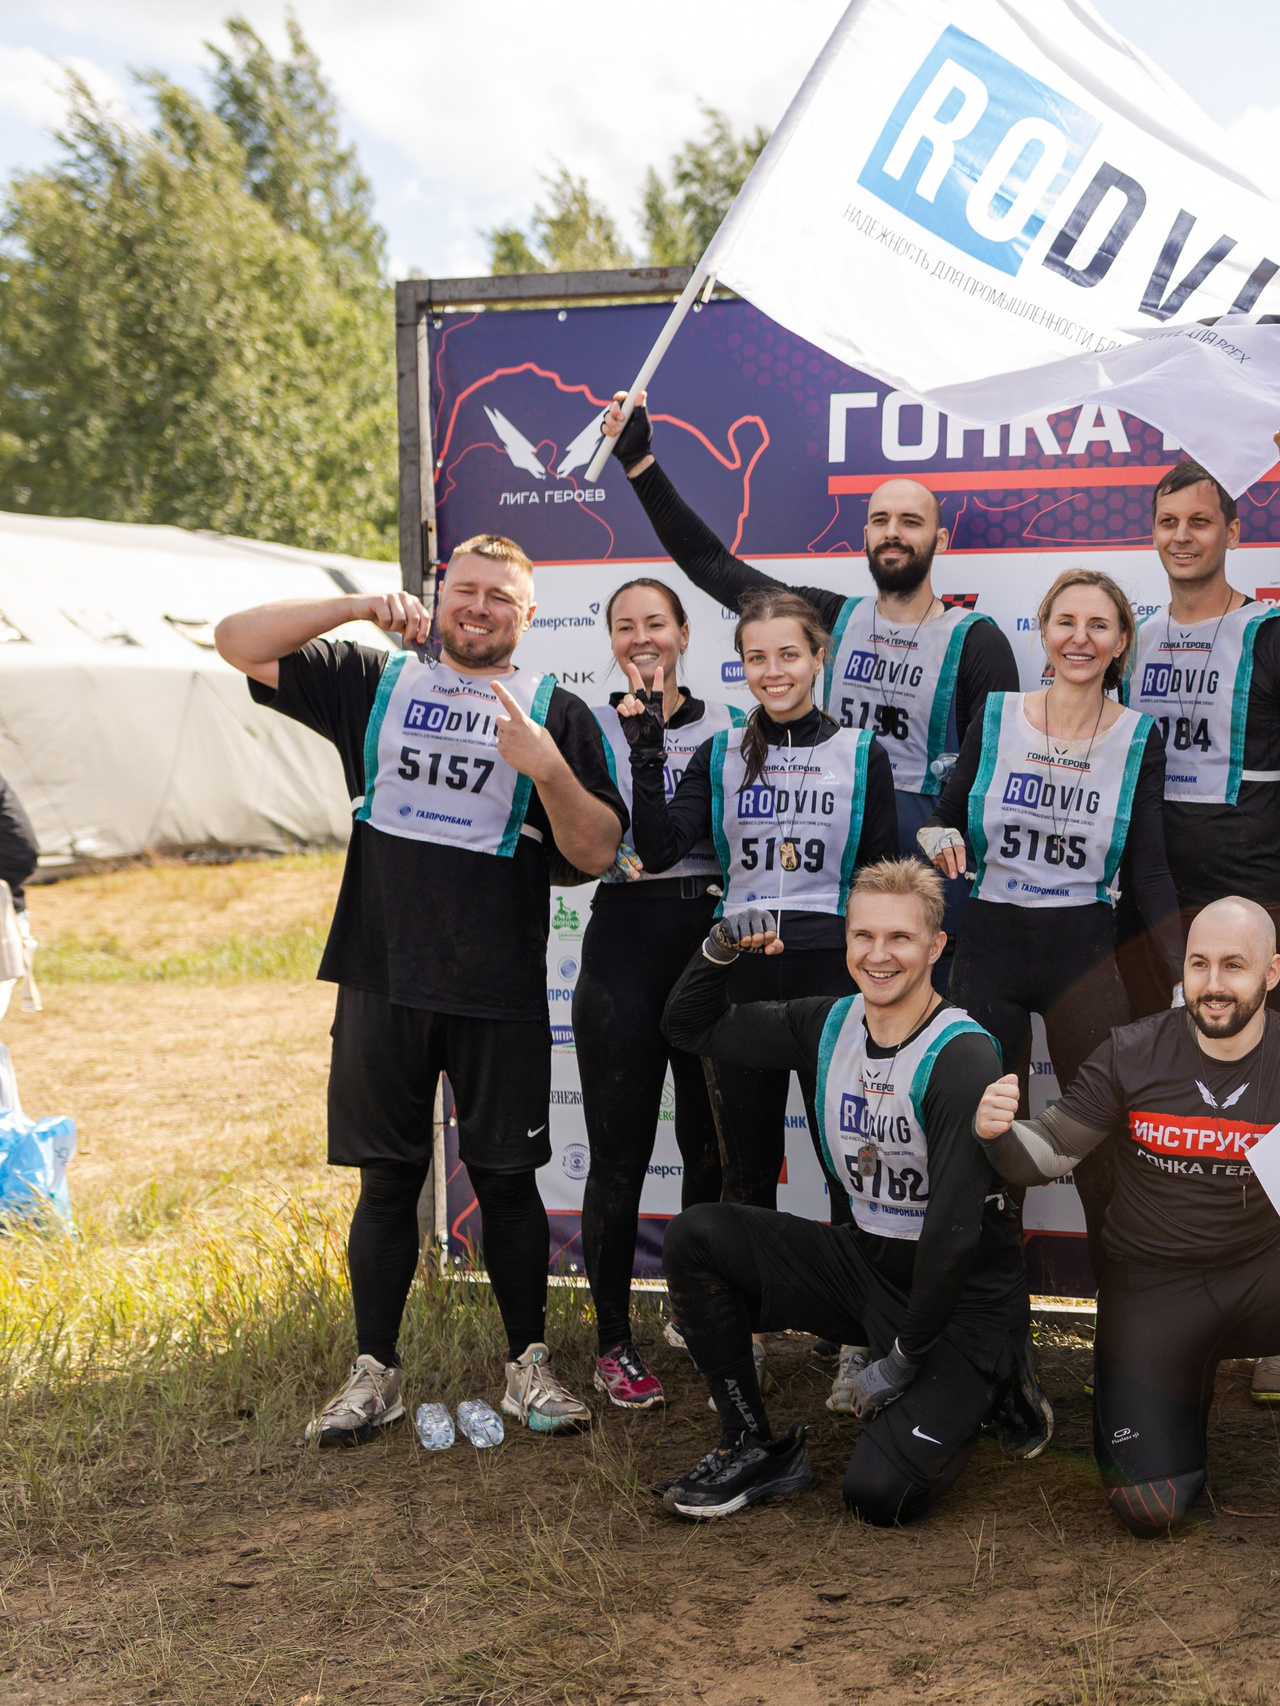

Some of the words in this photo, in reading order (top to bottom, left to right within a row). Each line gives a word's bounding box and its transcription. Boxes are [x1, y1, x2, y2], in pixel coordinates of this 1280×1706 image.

[843, 203, 930, 270] НАДЕЖНОСТЬ
[930, 260, 965, 288] ДЛЯ
[1213, 338, 1252, 365] ВСЕХ
[499, 491, 540, 506] ЛИГА
[544, 488, 606, 503] ГЕРОЕВ
[529, 615, 595, 631] еверсталь
[1160, 641, 1181, 649] ГОНКА
[1182, 641, 1212, 650] ГЕРОЕВ
[847, 655, 924, 688] RODVIG
[1143, 668, 1220, 694] RODVIG
[432, 684, 460, 695] ГОНКА
[462, 686, 497, 700] ГЕРОЕВ
[408, 702, 499, 737] RODVI
[398, 745, 495, 794] 5157
[788, 764, 821, 773] ГЕРОЕВ
[1027, 752, 1055, 763] ГОНКА
[1057, 758, 1091, 770] ГЕРОЕВ
[741, 789, 835, 816] RODVIG
[1006, 777, 1101, 815] RODVIG
[415, 809, 473, 827] ГАЗПРОМБАНК
[1000, 823, 1087, 871] 5165
[1021, 882, 1070, 897] ГАЗПРОМБАНК
[646, 1164, 684, 1178] верст
[1137, 1148, 1204, 1175] ГОНКА
